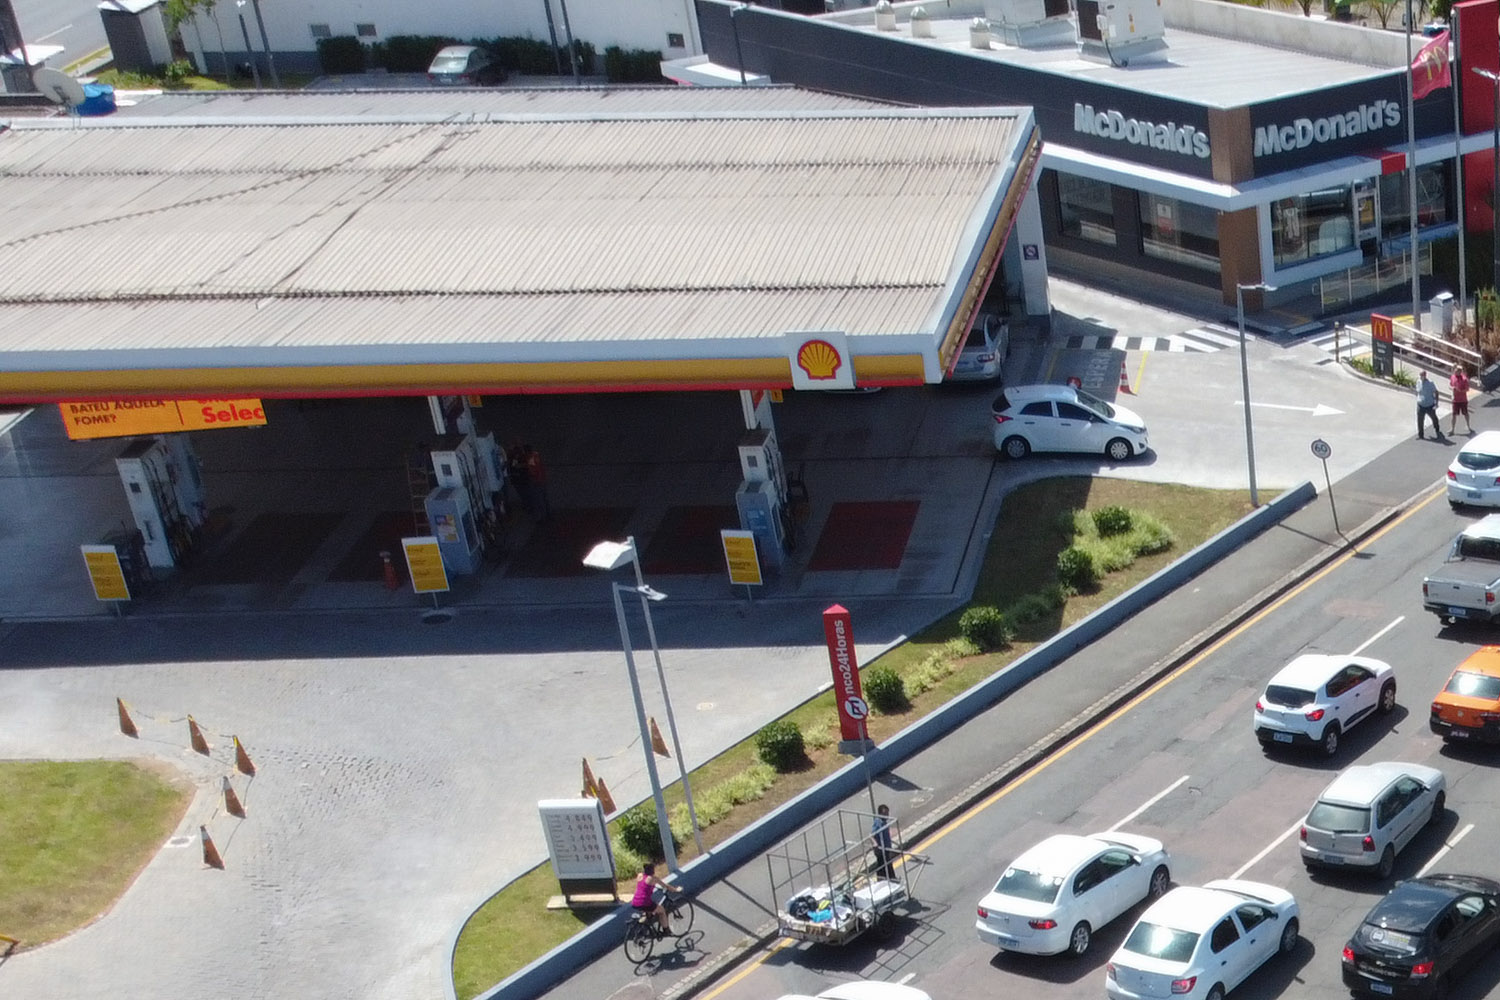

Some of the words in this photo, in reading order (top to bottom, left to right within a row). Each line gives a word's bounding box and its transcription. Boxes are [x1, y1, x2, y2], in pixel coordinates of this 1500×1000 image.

[1074, 103, 1210, 158] McDonald's
[1253, 100, 1400, 157] McDonald's
[70, 402, 110, 414] BATEU
[74, 414, 117, 426] FOME?
[834, 619, 855, 696] nco24Horas
